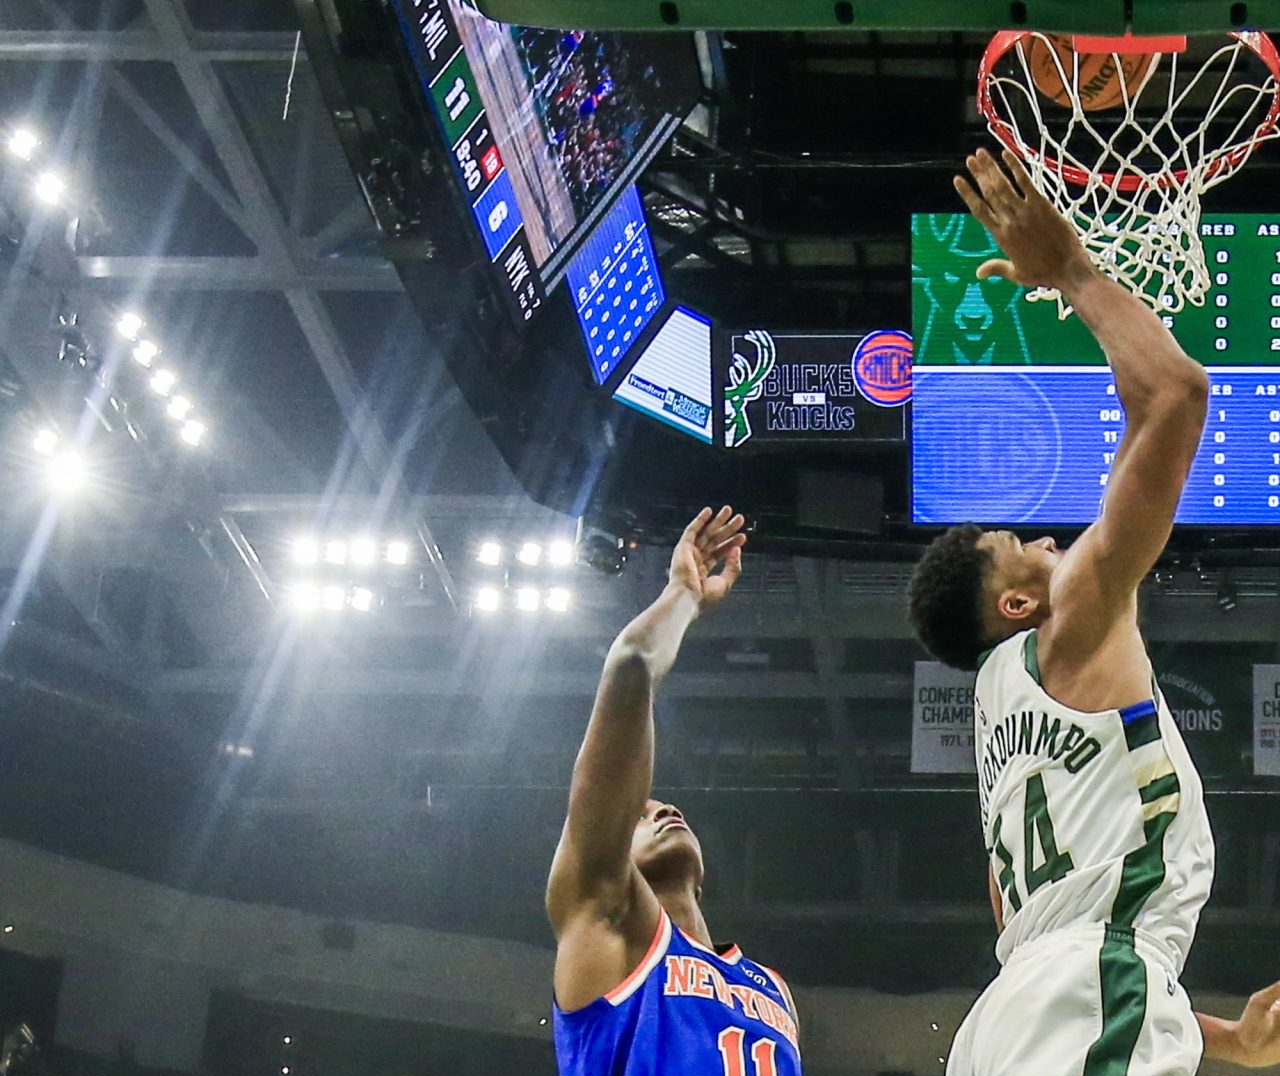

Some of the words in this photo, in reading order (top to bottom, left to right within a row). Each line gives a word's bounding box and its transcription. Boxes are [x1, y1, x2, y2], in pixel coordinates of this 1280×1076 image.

[421, 9, 449, 61] MIL
[444, 76, 470, 122] 11
[456, 139, 482, 191] 9:40
[488, 200, 509, 233] 6
[1201, 224, 1235, 236] REB
[1216, 251, 1228, 263] 0
[504, 245, 531, 292] NYK
[1216, 273, 1228, 285] 0
[1215, 295, 1228, 307] 0
[1215, 316, 1227, 328] 0
[1215, 338, 1227, 350] 0
[764, 364, 856, 397] BUCKS
[1211, 384, 1233, 396] EB
[767, 401, 855, 431] Knicks
[1099, 409, 1121, 422] 00
[1218, 409, 1226, 422] 1
[1269, 410, 1280, 422] 0
[1103, 430, 1118, 443] 11
[1214, 431, 1226, 443] 0
[1268, 431, 1280, 443] 0
[1213, 452, 1226, 465] 0
[1272, 452, 1280, 465] 1
[1213, 474, 1225, 486] 0
[1268, 474, 1280, 486] 0
[1213, 495, 1225, 507] 0
[1268, 495, 1280, 508] 0
[918, 687, 975, 704] CONFER
[922, 706, 974, 724] CHAMP
[1172, 709, 1223, 732] PIONS
[663, 955, 735, 1010] NEW
